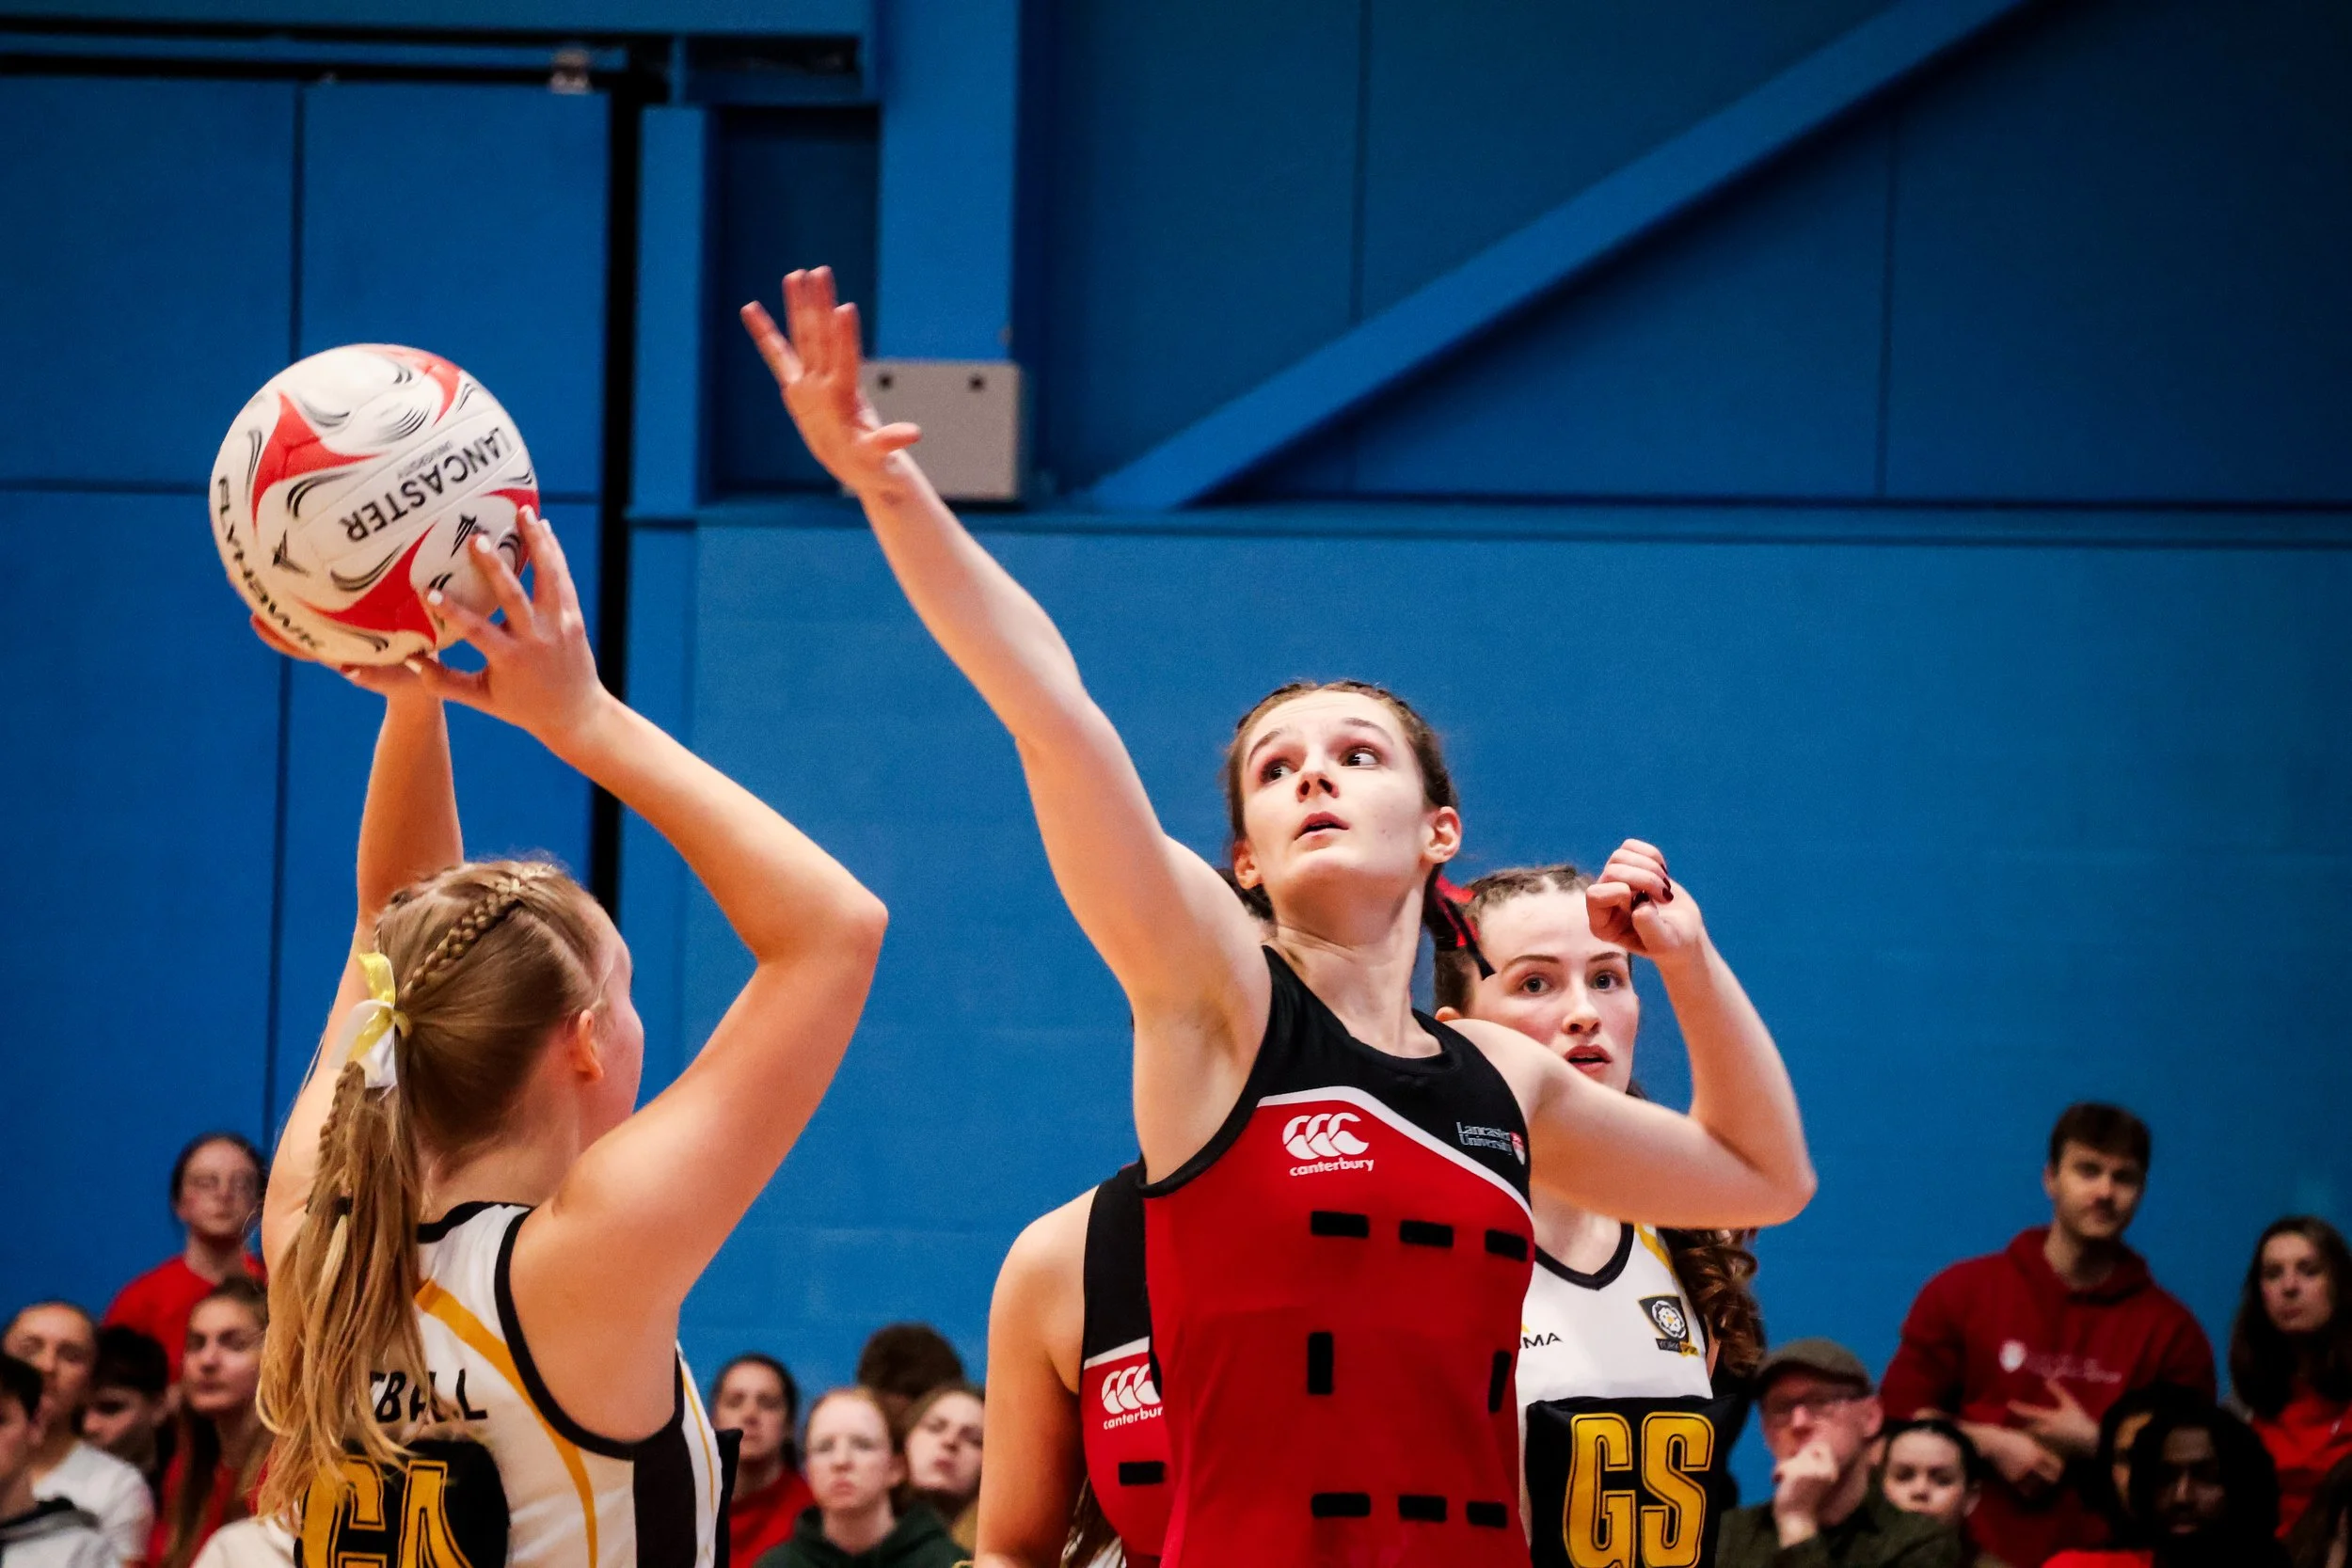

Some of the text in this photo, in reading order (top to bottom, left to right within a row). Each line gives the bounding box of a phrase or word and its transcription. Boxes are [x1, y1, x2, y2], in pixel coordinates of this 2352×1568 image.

[340, 426, 512, 543] LANCASTER
[1289, 1156, 1375, 1177] canterbury
[1103, 1405, 1164, 1431] canterbur
[1563, 1411, 1715, 1568] GS
